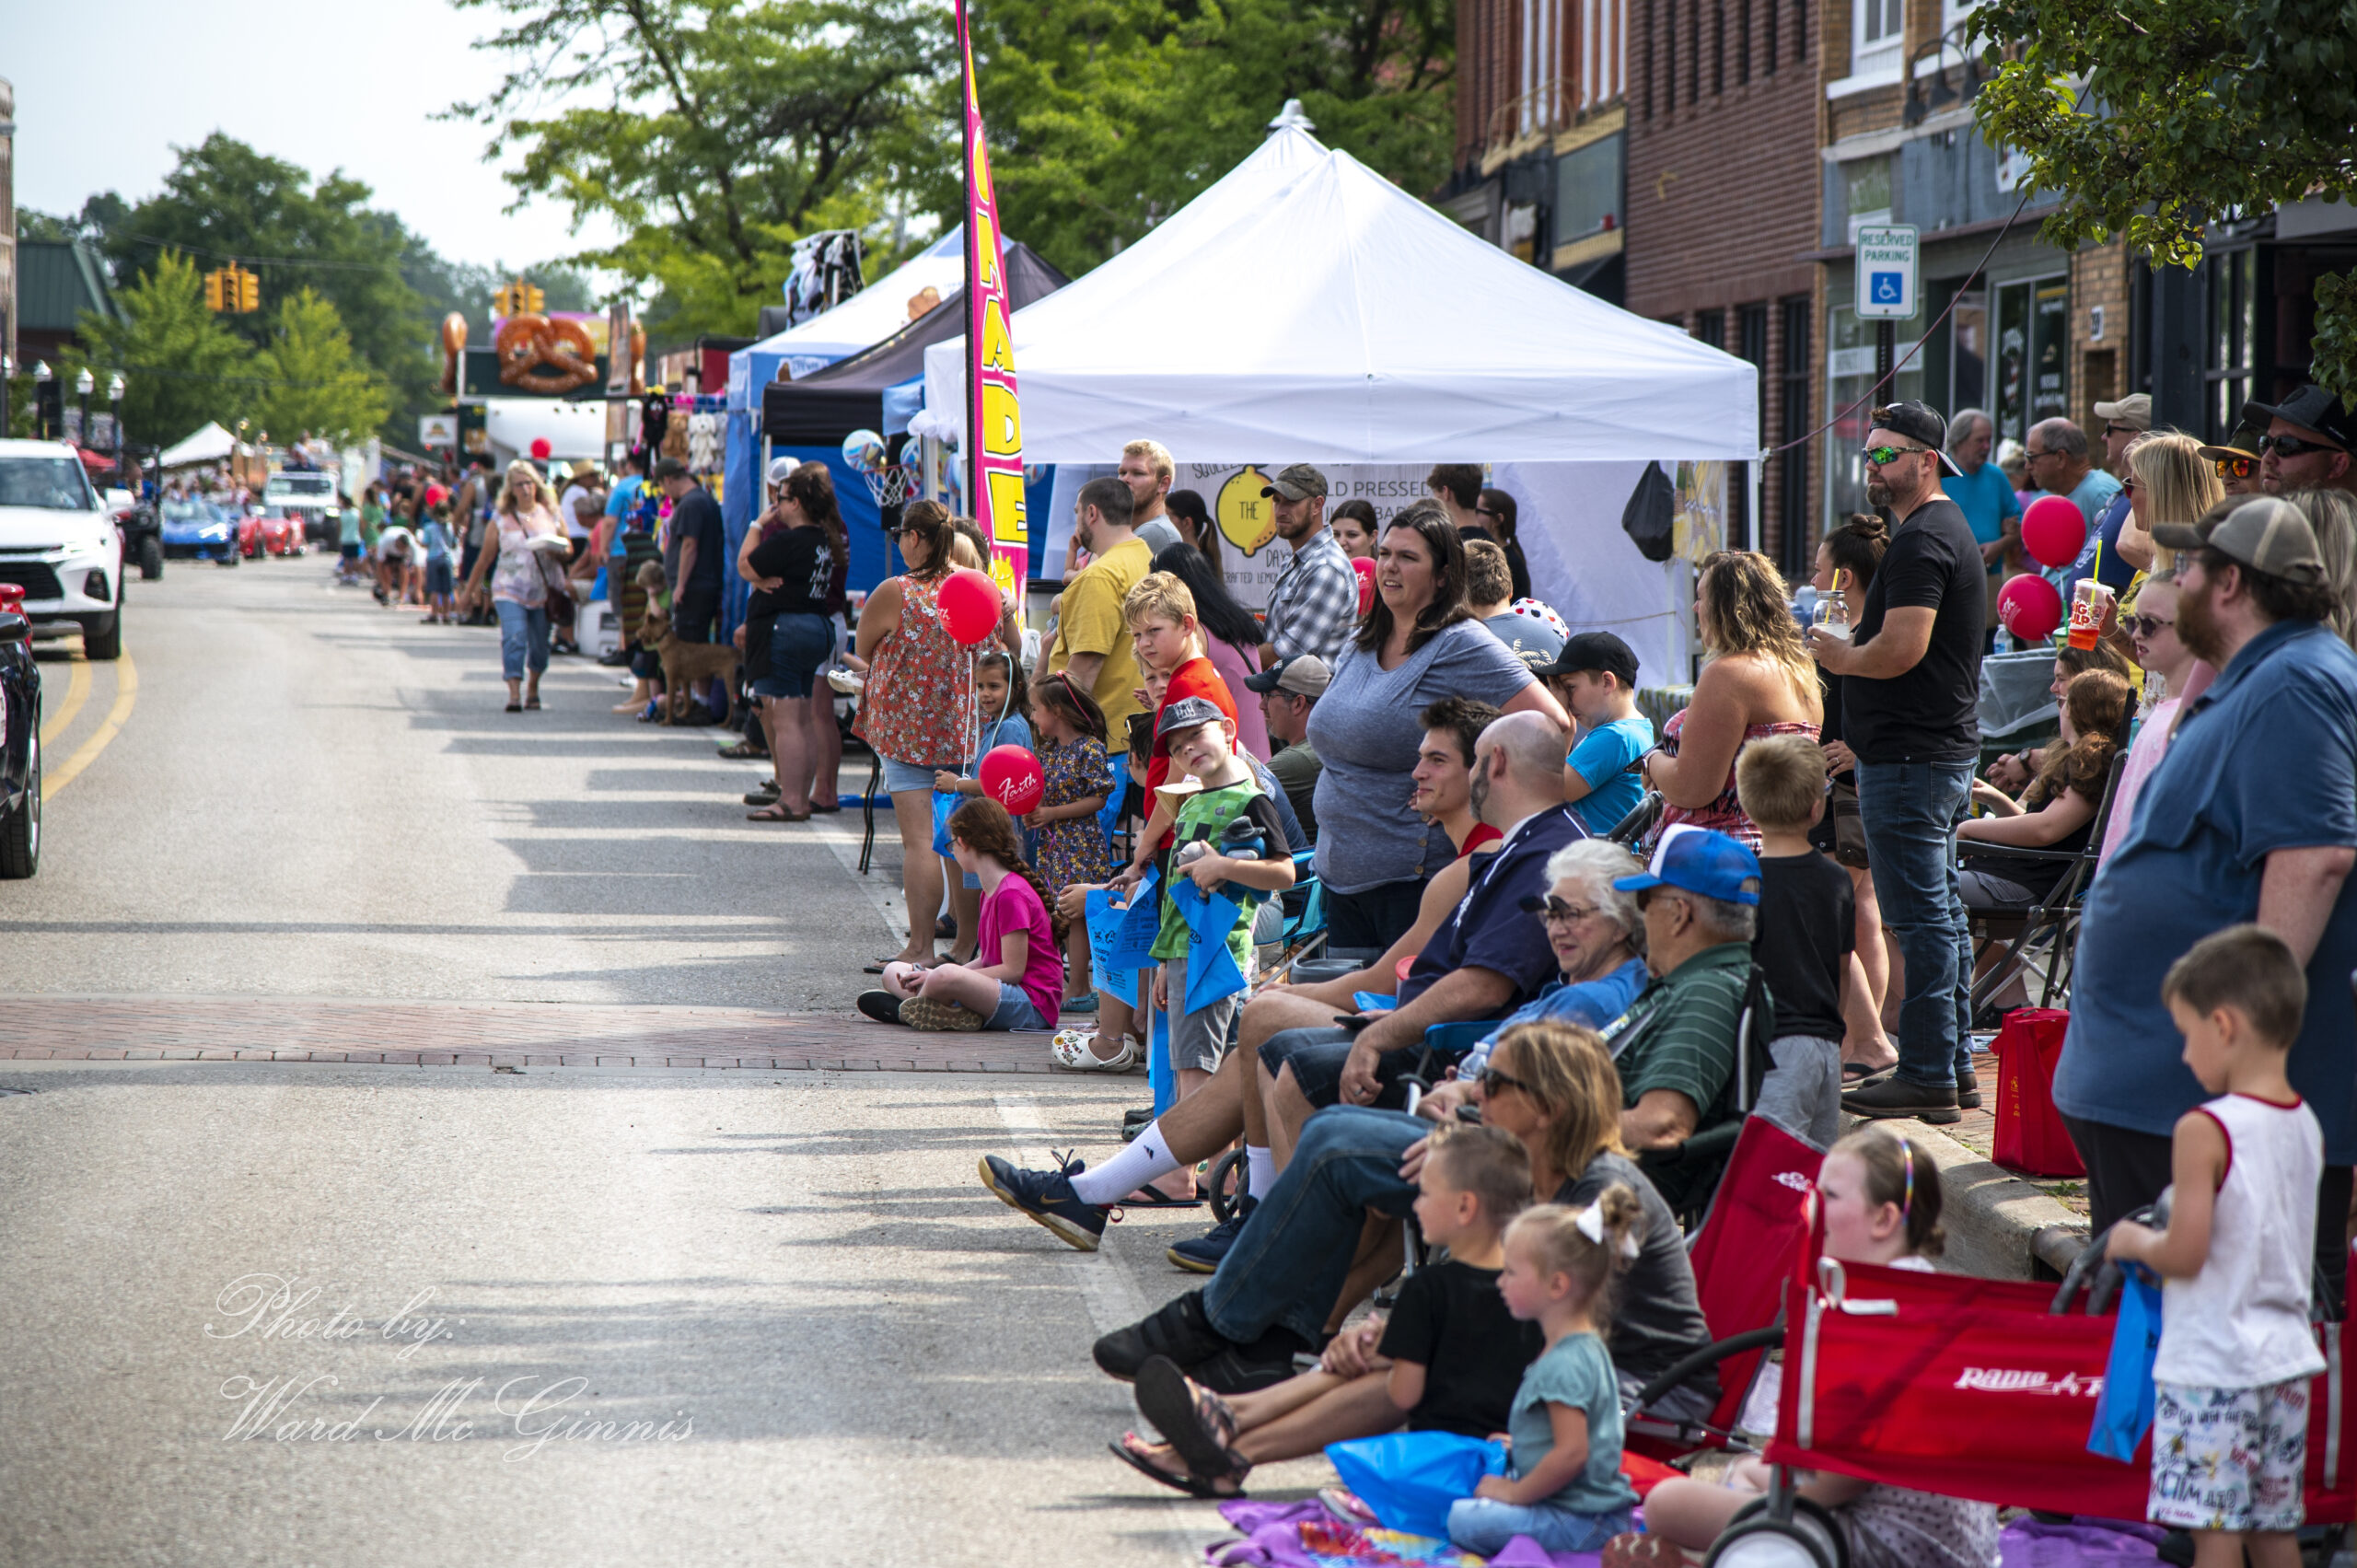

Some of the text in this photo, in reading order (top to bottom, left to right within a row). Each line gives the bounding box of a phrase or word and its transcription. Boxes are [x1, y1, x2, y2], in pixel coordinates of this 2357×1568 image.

[1861, 233, 1913, 247] RESERVED
[1864, 250, 1910, 262] PARKING
[1238, 501, 1260, 520] THE
[2071, 614, 2090, 626] ULP
[998, 772, 1037, 806] Faith
[1954, 1366, 2049, 1392] RADIO
